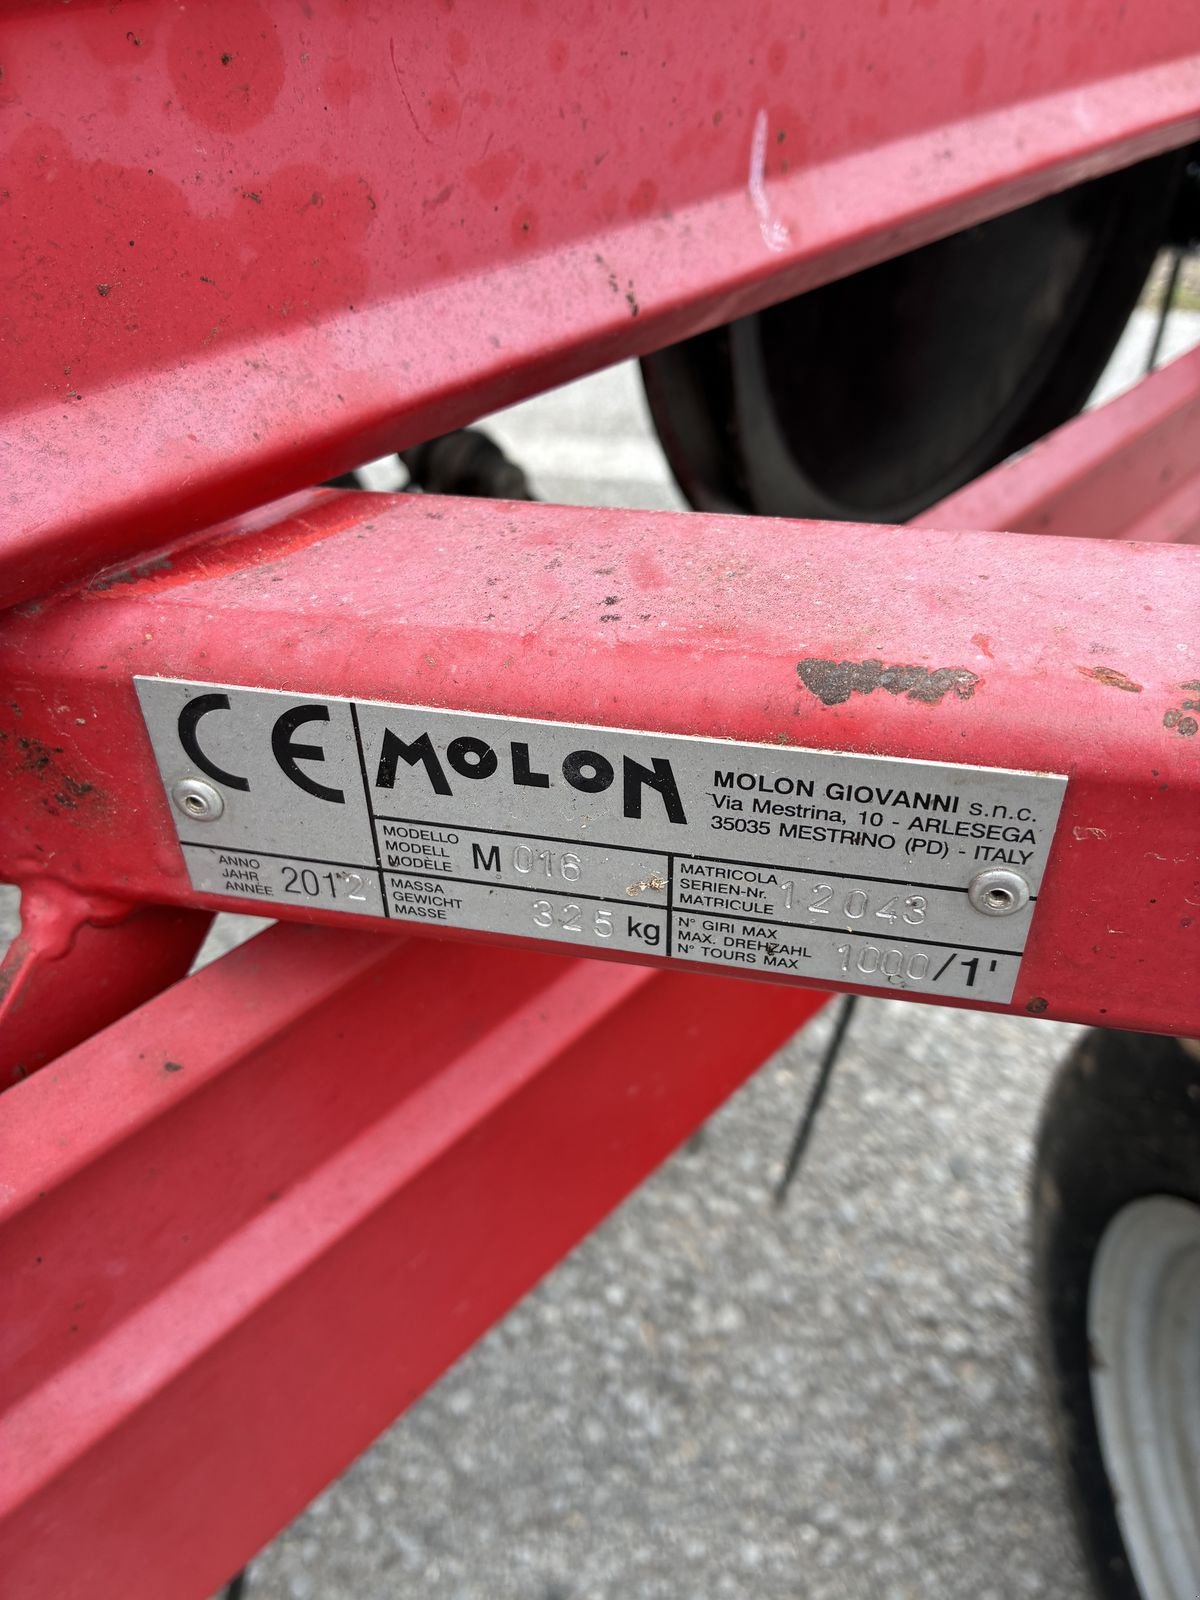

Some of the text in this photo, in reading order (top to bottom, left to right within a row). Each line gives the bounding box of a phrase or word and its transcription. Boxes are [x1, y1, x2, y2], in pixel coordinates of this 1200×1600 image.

[178, 693, 345, 804] CE
[376, 727, 688, 824] MOLON
[713, 770, 1037, 823] MOLON GIOVANNI s.n.c.
[711, 793, 744, 812] Via
[752, 798, 847, 826] Mestrina,
[858, 810, 884, 828] 10
[907, 816, 1037, 845] ARLESEGA
[382, 825, 459, 845] MODELLO
[710, 815, 771, 836] 35035
[778, 822, 896, 850] MESTRINO
[904, 837, 949, 860] (PD)
[973, 845, 1035, 866] ITALY
[385, 840, 451, 858] MODELL
[218, 854, 260, 870] ANNO
[387, 854, 453, 873] MODÈLE
[471, 843, 582, 882] M 016
[222, 869, 260, 882] JAHR
[281, 866, 367, 901] 2012
[390, 878, 445, 894] MASSA
[680, 863, 778, 886] MATRICOLA
[225, 879, 274, 896] ANNÉE
[679, 878, 767, 900] SERIEN-Nr.
[392, 891, 463, 909] GEWICHT
[395, 903, 448, 920] MASSE
[679, 893, 774, 916] MATRICULE
[779, 880, 928, 925] 12043
[533, 900, 661, 946] 325 kg
[702, 920, 735, 934] GIRI
[742, 925, 778, 940] MAX
[678, 930, 812, 958] MAX. DREHZAHL
[701, 946, 757, 963] TOURS
[763, 955, 799, 970] MAX
